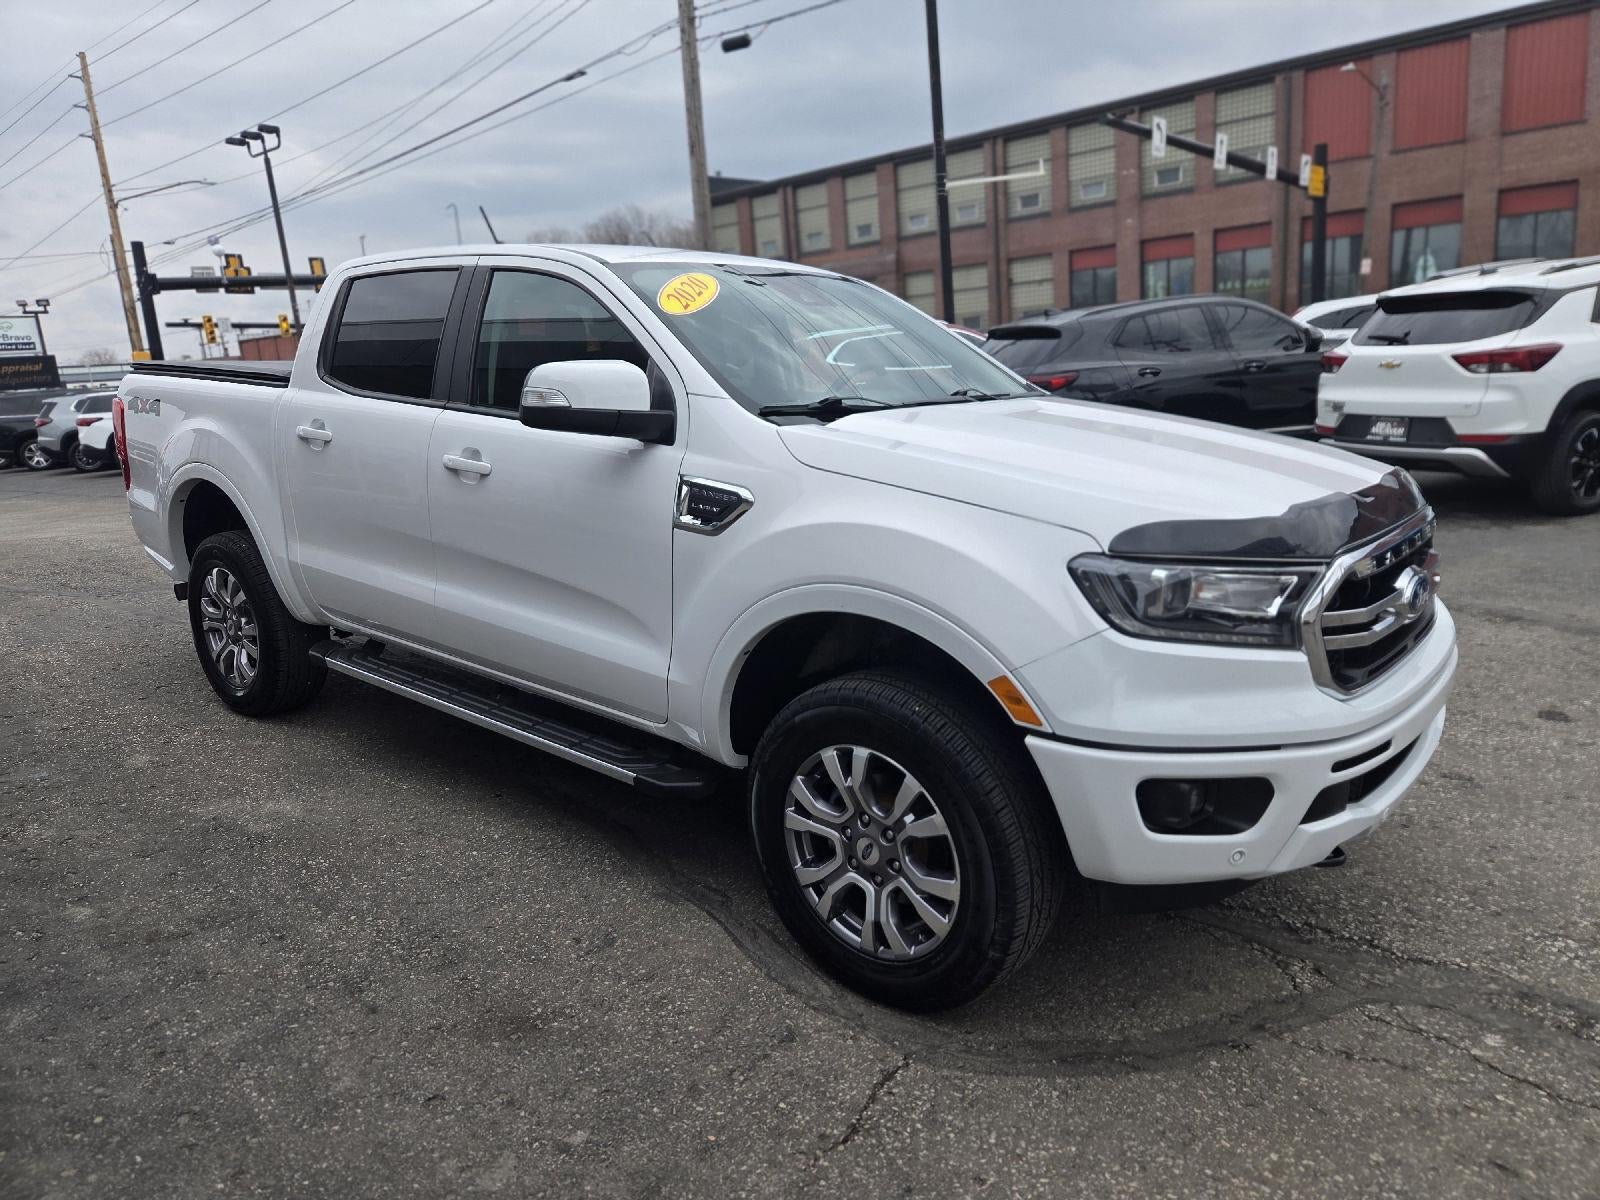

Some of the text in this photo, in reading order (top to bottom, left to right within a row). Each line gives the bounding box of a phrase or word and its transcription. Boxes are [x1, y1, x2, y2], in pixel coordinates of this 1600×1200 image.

[666, 275, 709, 311] 2020
[0, 362, 43, 374] ppraisal
[691, 487, 738, 501] RANGER
